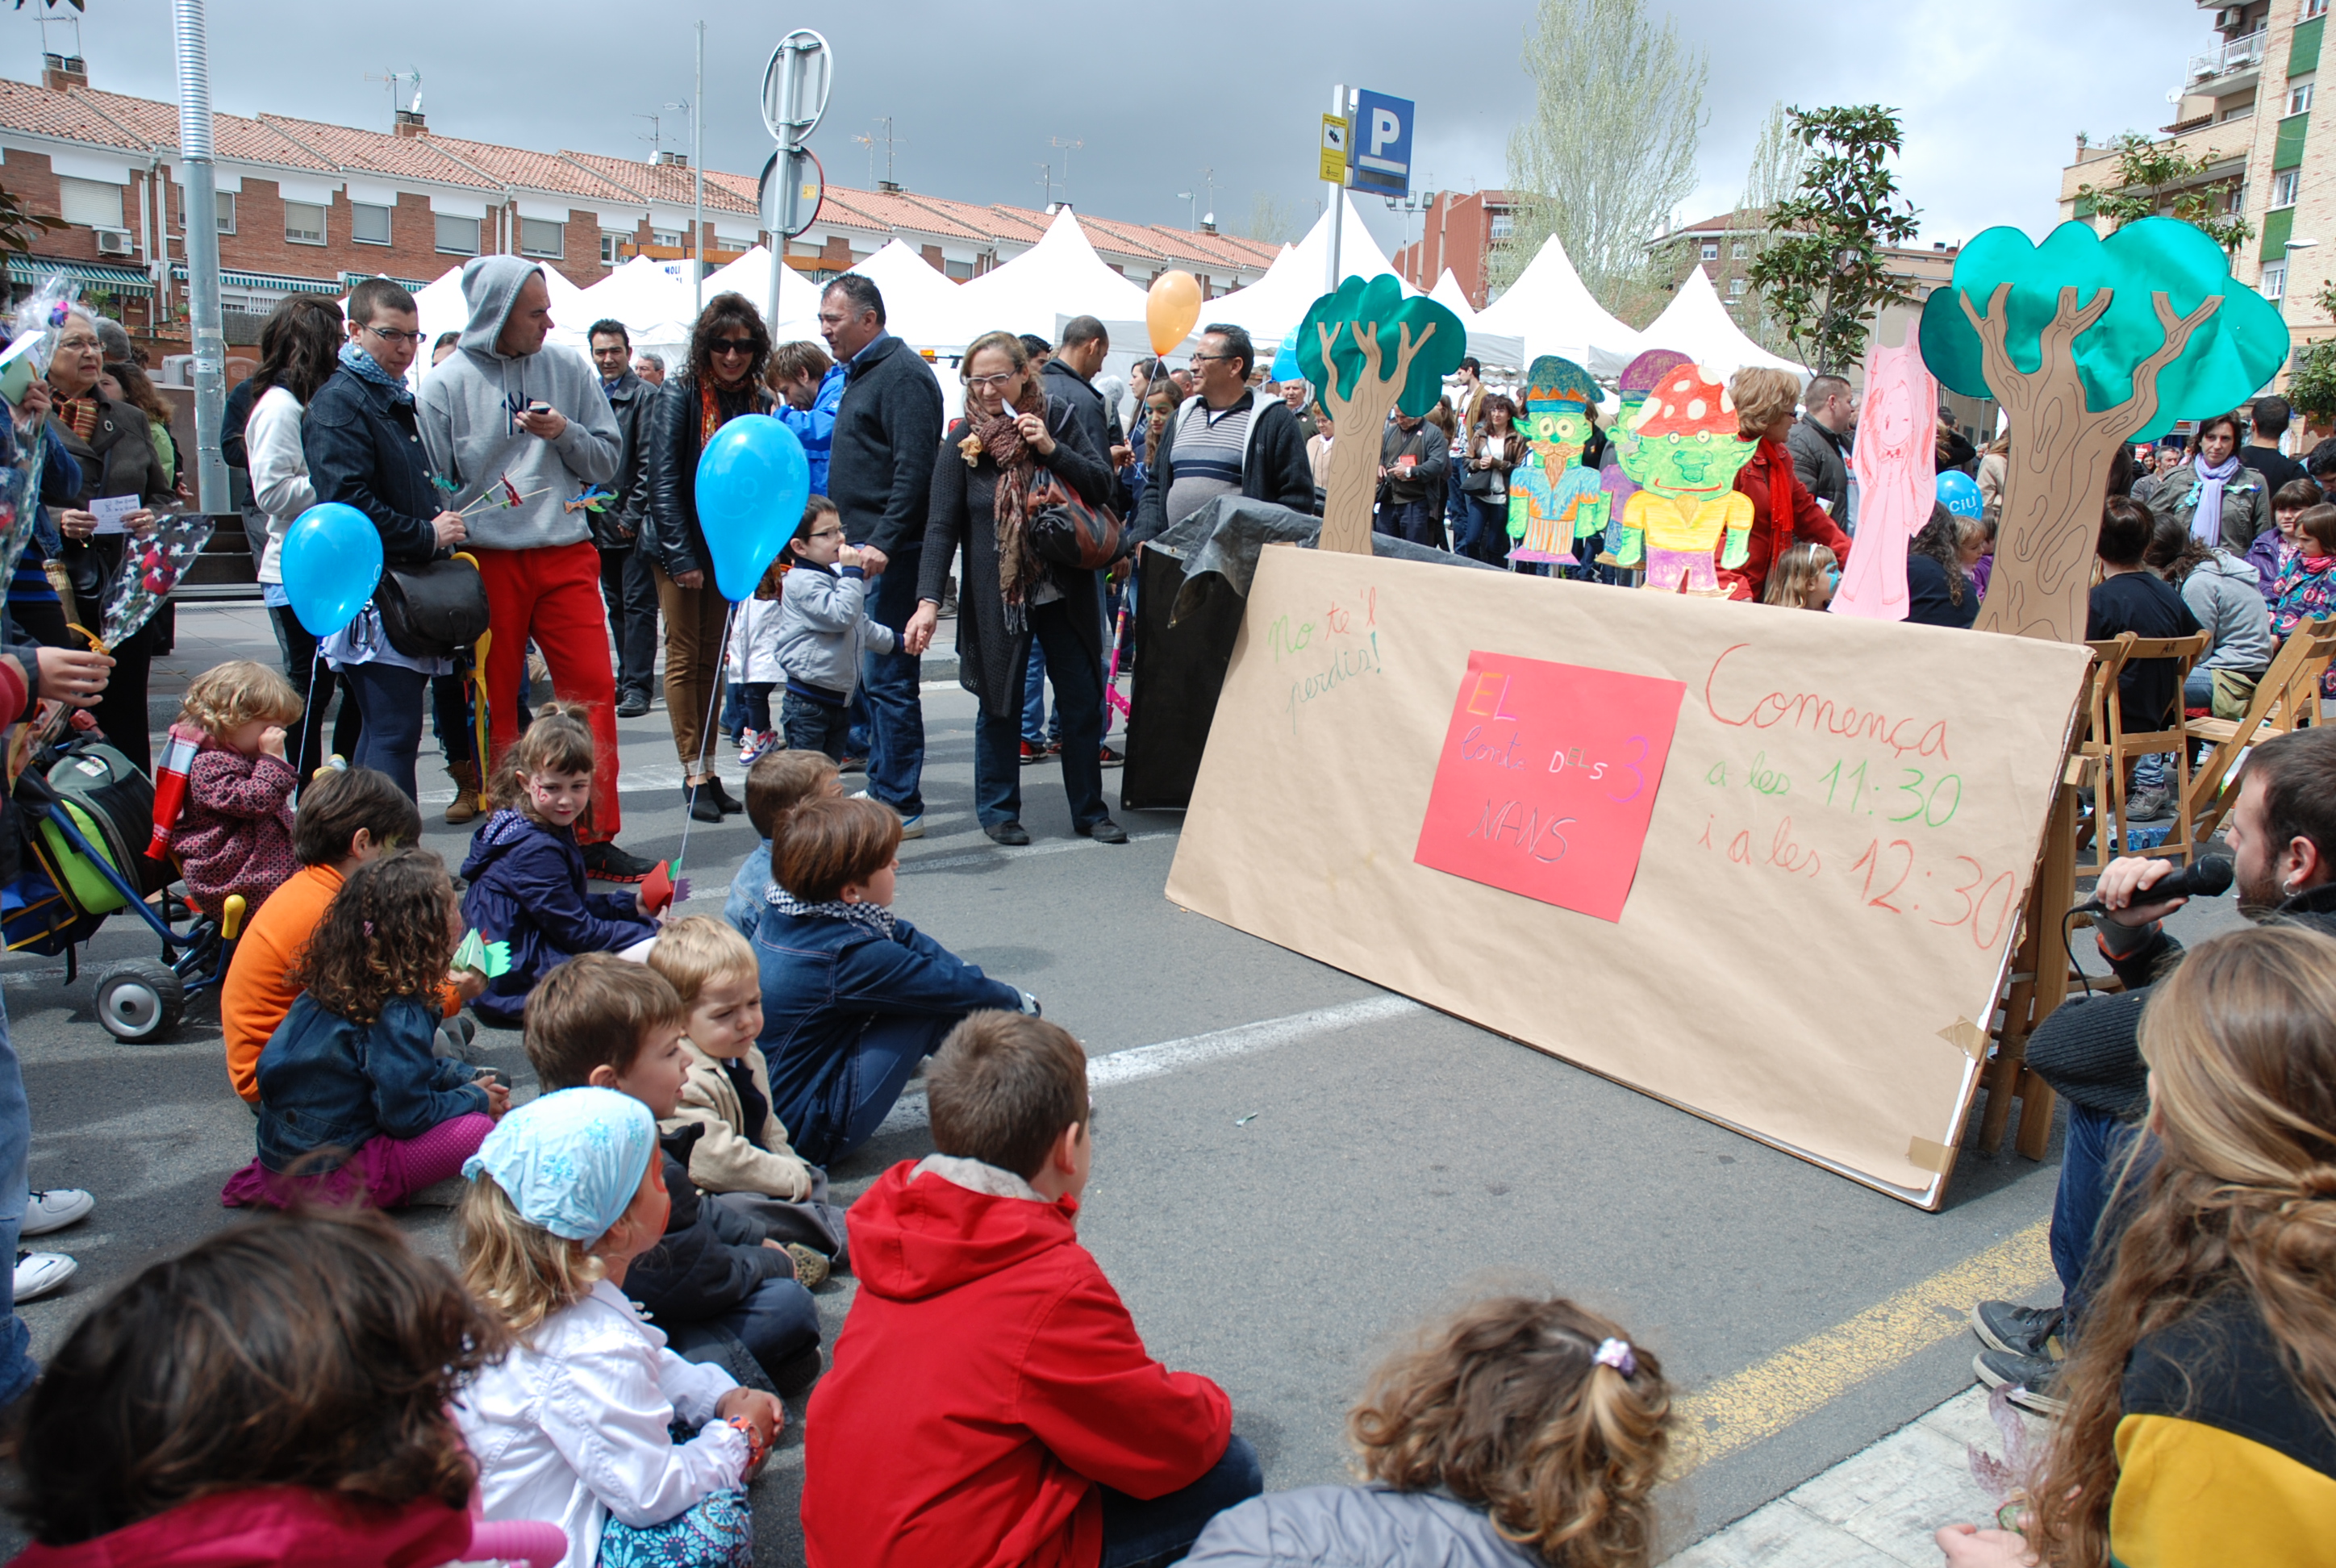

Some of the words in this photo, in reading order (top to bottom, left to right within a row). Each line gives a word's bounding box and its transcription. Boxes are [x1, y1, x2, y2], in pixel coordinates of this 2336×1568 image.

[1370, 107, 1400, 156] P
[1286, 631, 1383, 734] perdis!
[1466, 672, 1516, 721] EL
[1705, 643, 1950, 761] Comença
[1548, 747, 1608, 779] DELS
[1607, 734, 1649, 803] 3
[1704, 761, 1726, 787] a
[1744, 751, 1791, 795] les
[1818, 758, 1962, 828] 11:30
[1468, 798, 1578, 863] NANS
[1698, 814, 1712, 850] i
[1728, 829, 1752, 865] a
[1765, 815, 1821, 878] les
[1850, 837, 2015, 950] 12:30
